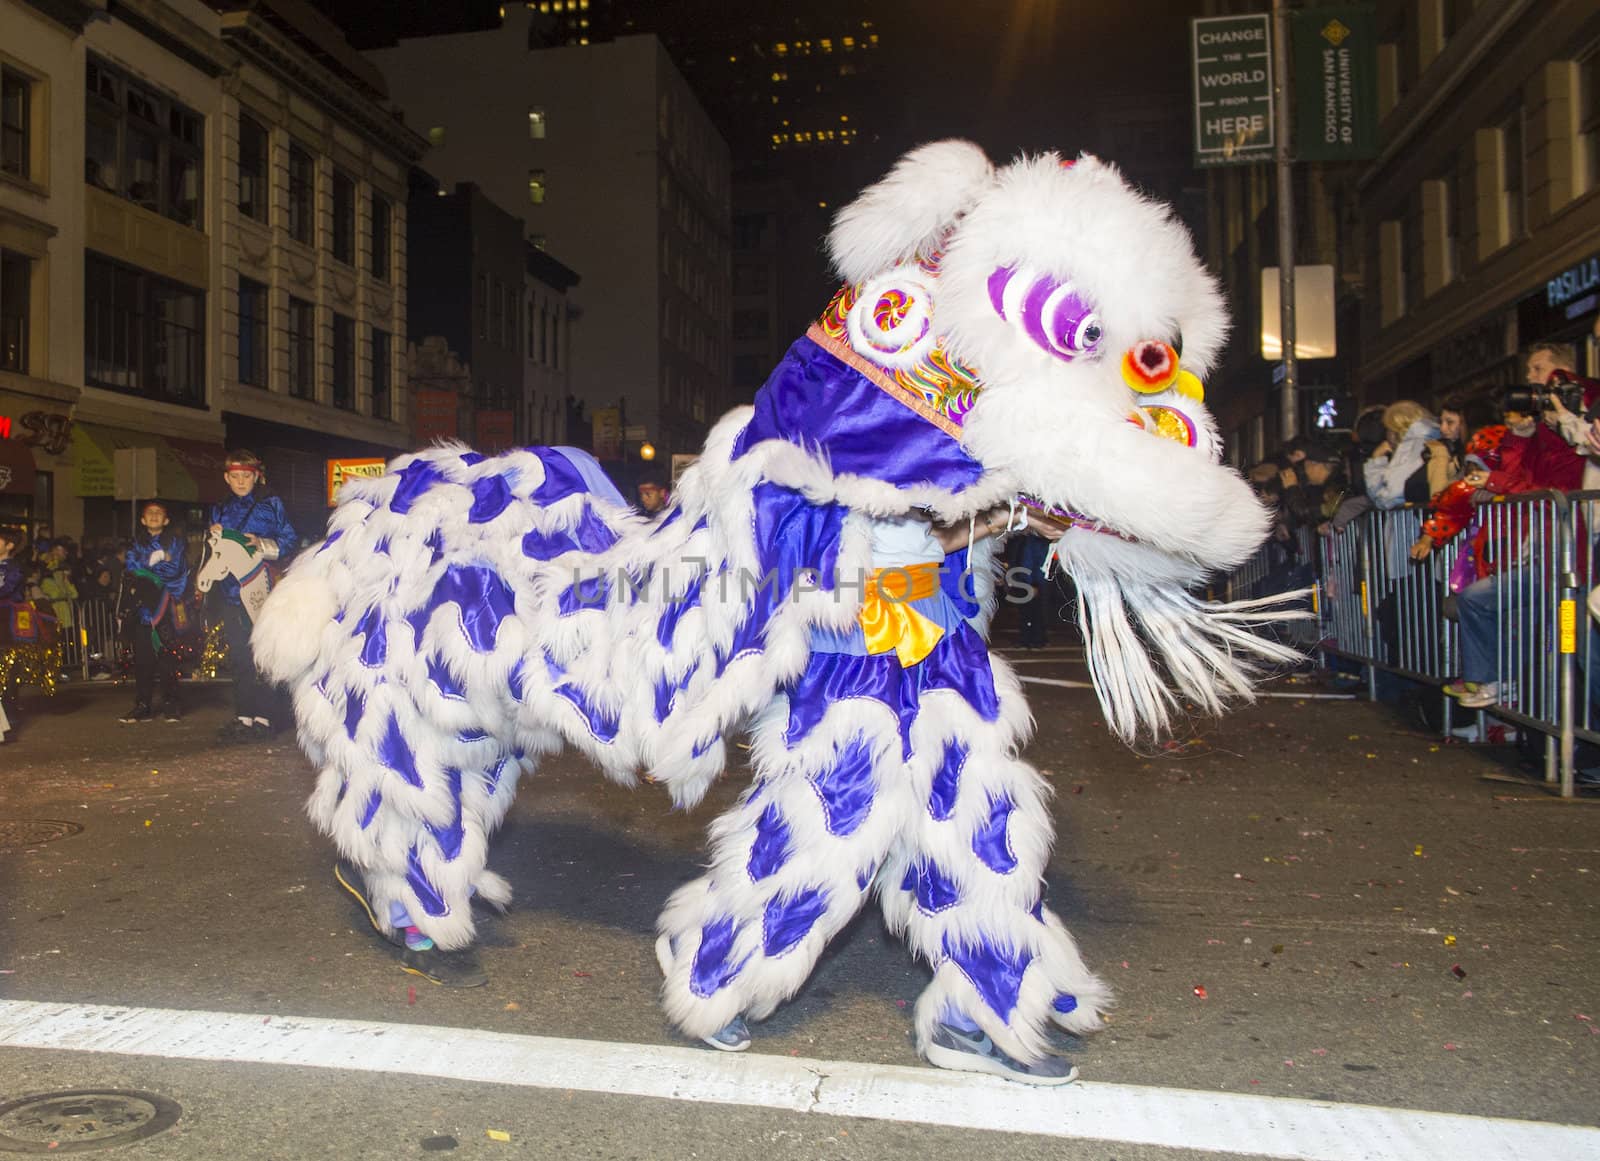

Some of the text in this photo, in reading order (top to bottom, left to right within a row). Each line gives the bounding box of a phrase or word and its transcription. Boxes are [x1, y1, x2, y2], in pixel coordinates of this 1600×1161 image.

[1200, 29, 1264, 44] CHANGE
[1201, 70, 1265, 87] WORLD
[1323, 49, 1337, 142] SAN FRANCISCO
[1339, 49, 1352, 143] UNIVERSITY OF
[1206, 115, 1264, 135] HERE
